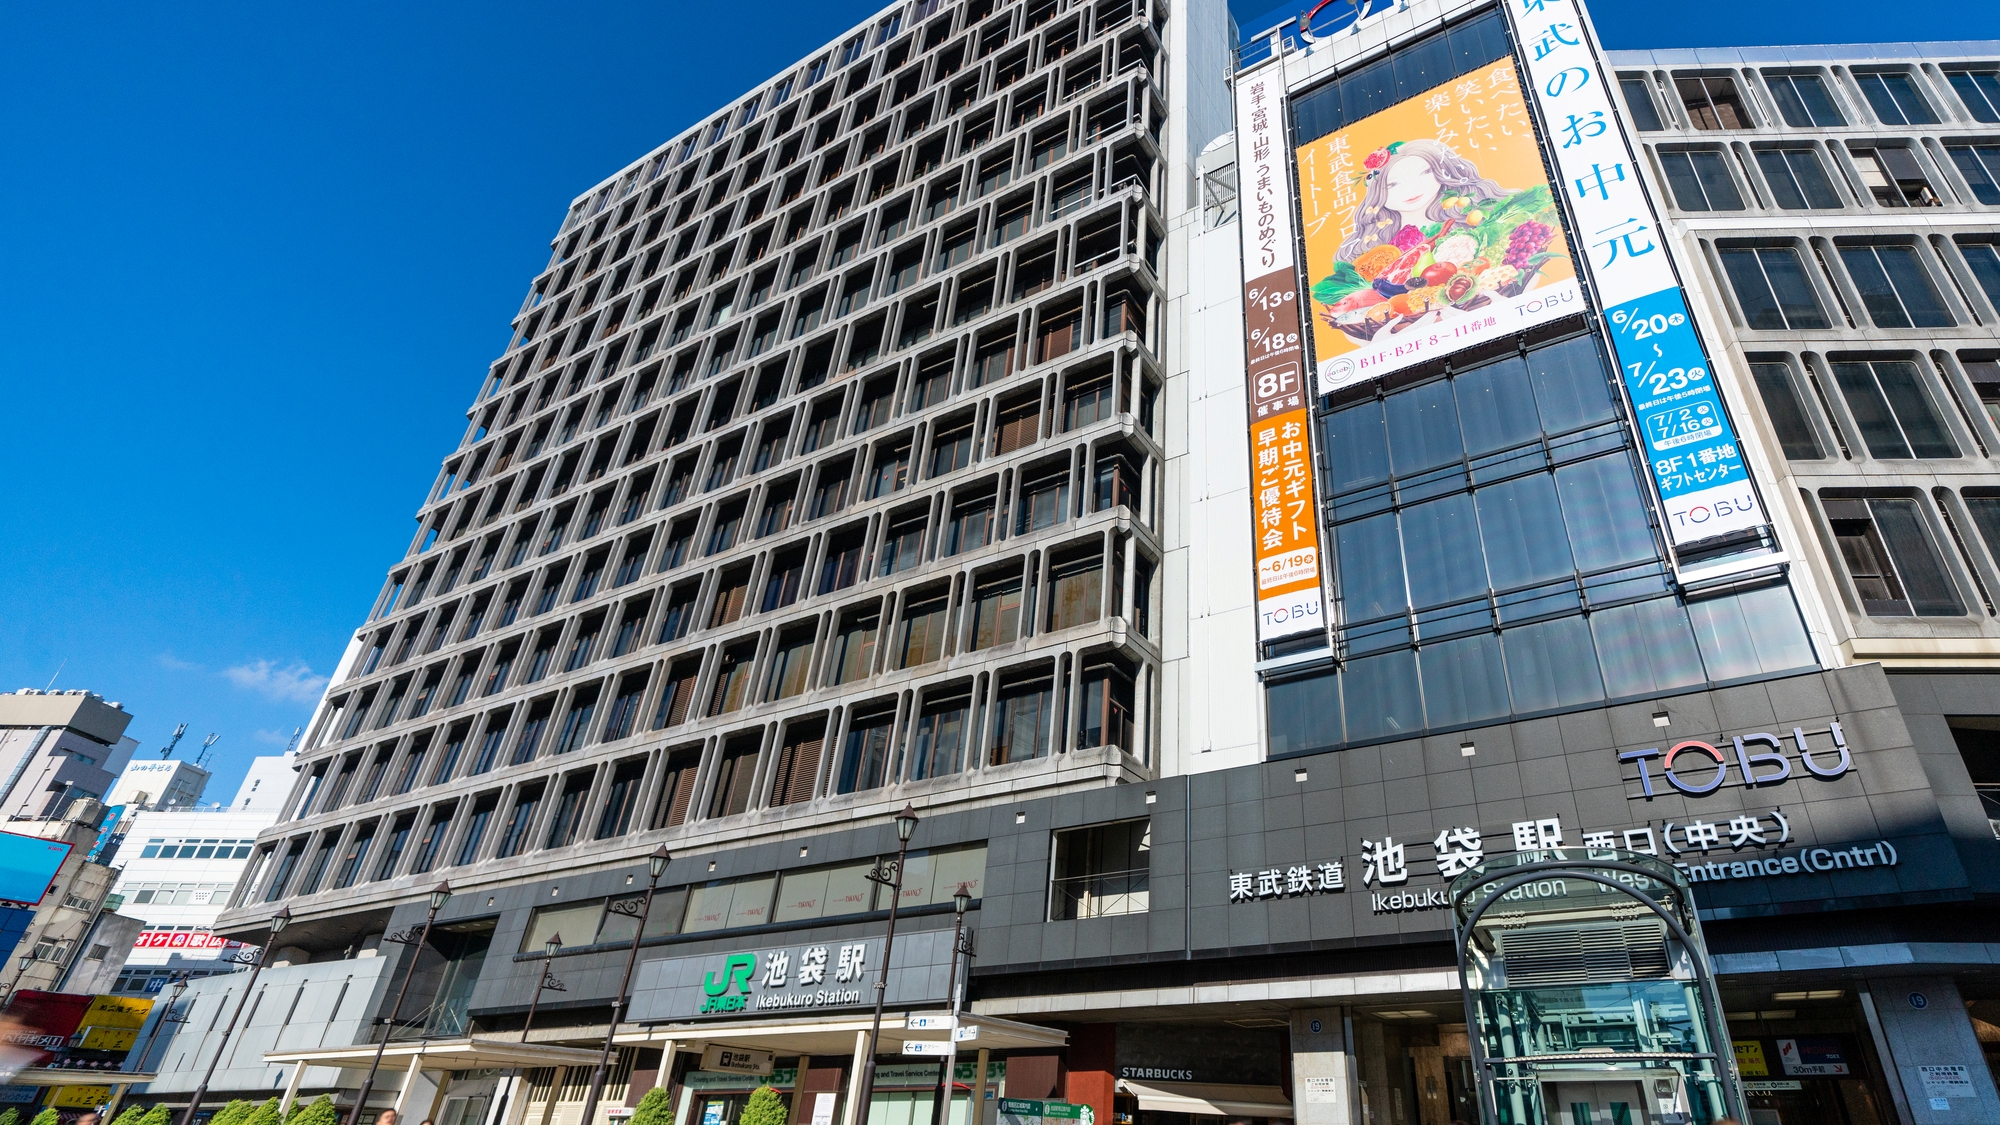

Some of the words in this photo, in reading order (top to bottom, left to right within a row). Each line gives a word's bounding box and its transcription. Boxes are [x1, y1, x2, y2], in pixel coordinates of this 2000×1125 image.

[1455, 78, 1497, 151] 笑いたい、
[1486, 66, 1531, 138] 食べたい、
[1325, 134, 1361, 260] 東武食品フロア
[1256, 163, 1277, 268] うまいものめぐり
[1515, 289, 1574, 317] TOBU
[1257, 370, 1295, 398] 8F
[1257, 396, 1300, 417] 催事場
[1664, 429, 1712, 447] 午後6時閉場
[1655, 455, 1683, 476] 8F
[1686, 443, 1737, 468] 1番地
[1258, 427, 1283, 551] 早期ご優待会
[1281, 421, 1307, 541] お中元ギフト
[1661, 463, 1742, 491] ギフトセンター
[1673, 494, 1753, 526] TOBU
[1263, 601, 1319, 626] TOBU
[1619, 721, 1851, 799] TOBU
[1228, 861, 1345, 902] 東武鉄道
[1361, 817, 1568, 889] 池袋駅
[704, 952, 757, 996] JR
[761, 943, 868, 988] 池袋駅
[700, 995, 748, 1013] JR東日本
[756, 991, 814, 1011] Ikebukuro
[816, 988, 861, 1005] Station
[732, 1053, 751, 1062] 池袋駅
[1122, 1067, 1193, 1080] STARBUCKS
